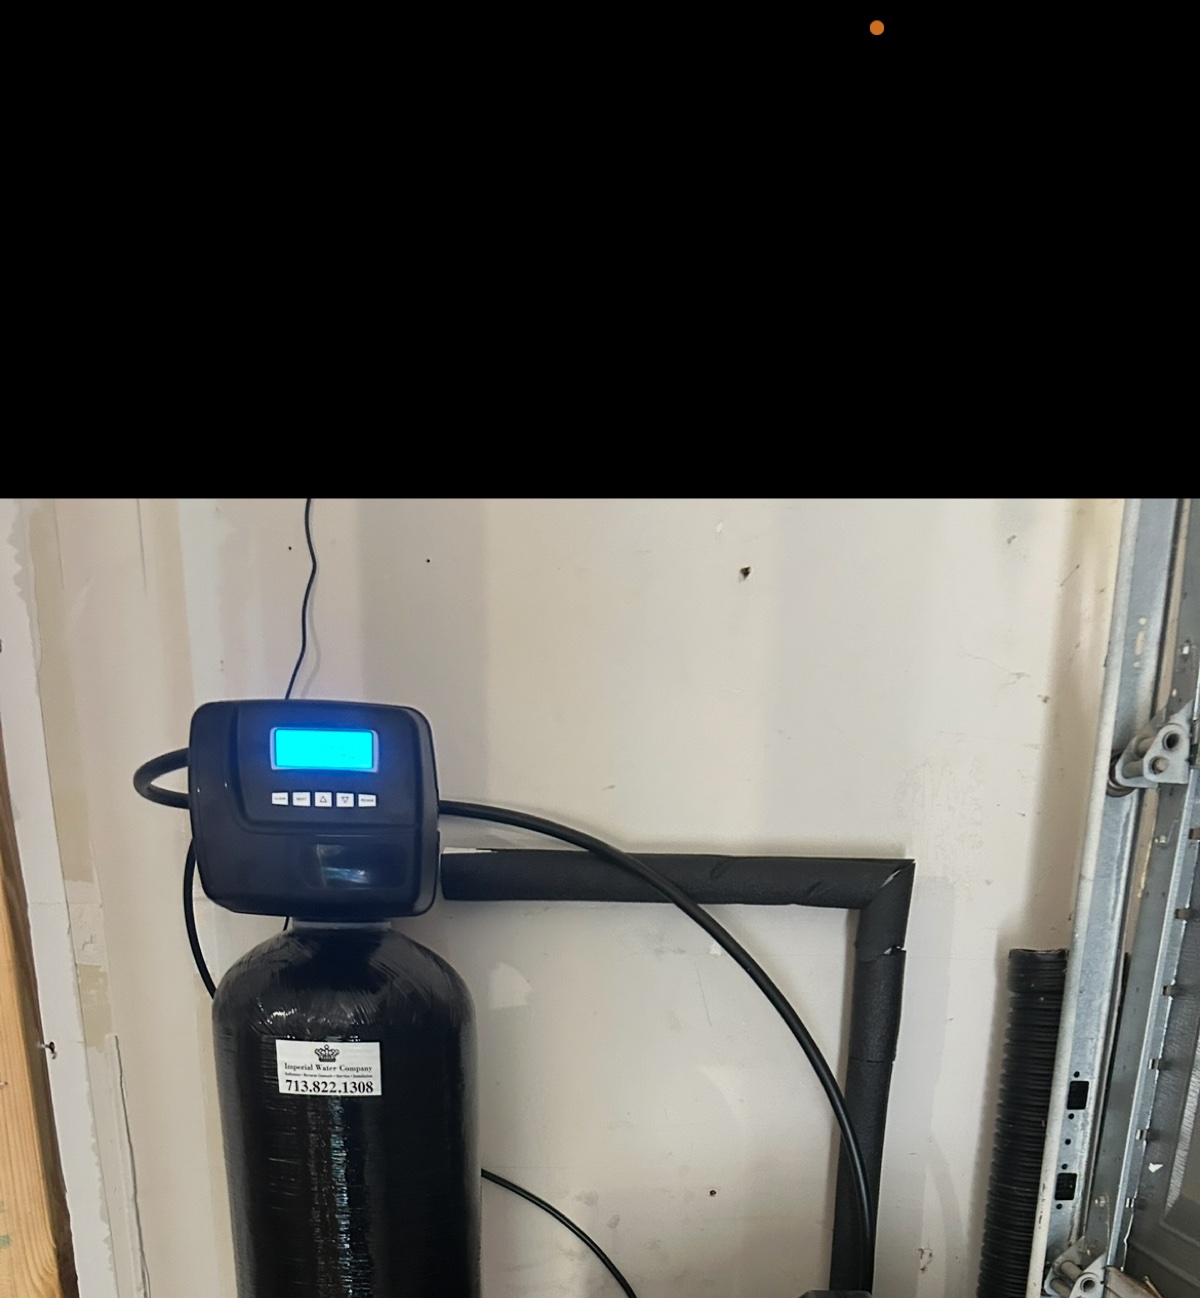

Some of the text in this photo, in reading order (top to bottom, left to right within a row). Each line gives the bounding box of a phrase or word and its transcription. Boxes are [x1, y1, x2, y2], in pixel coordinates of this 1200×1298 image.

[285, 1062, 372, 1073] Imperial Water Company
[285, 1079, 374, 1094] 713.822.1308
